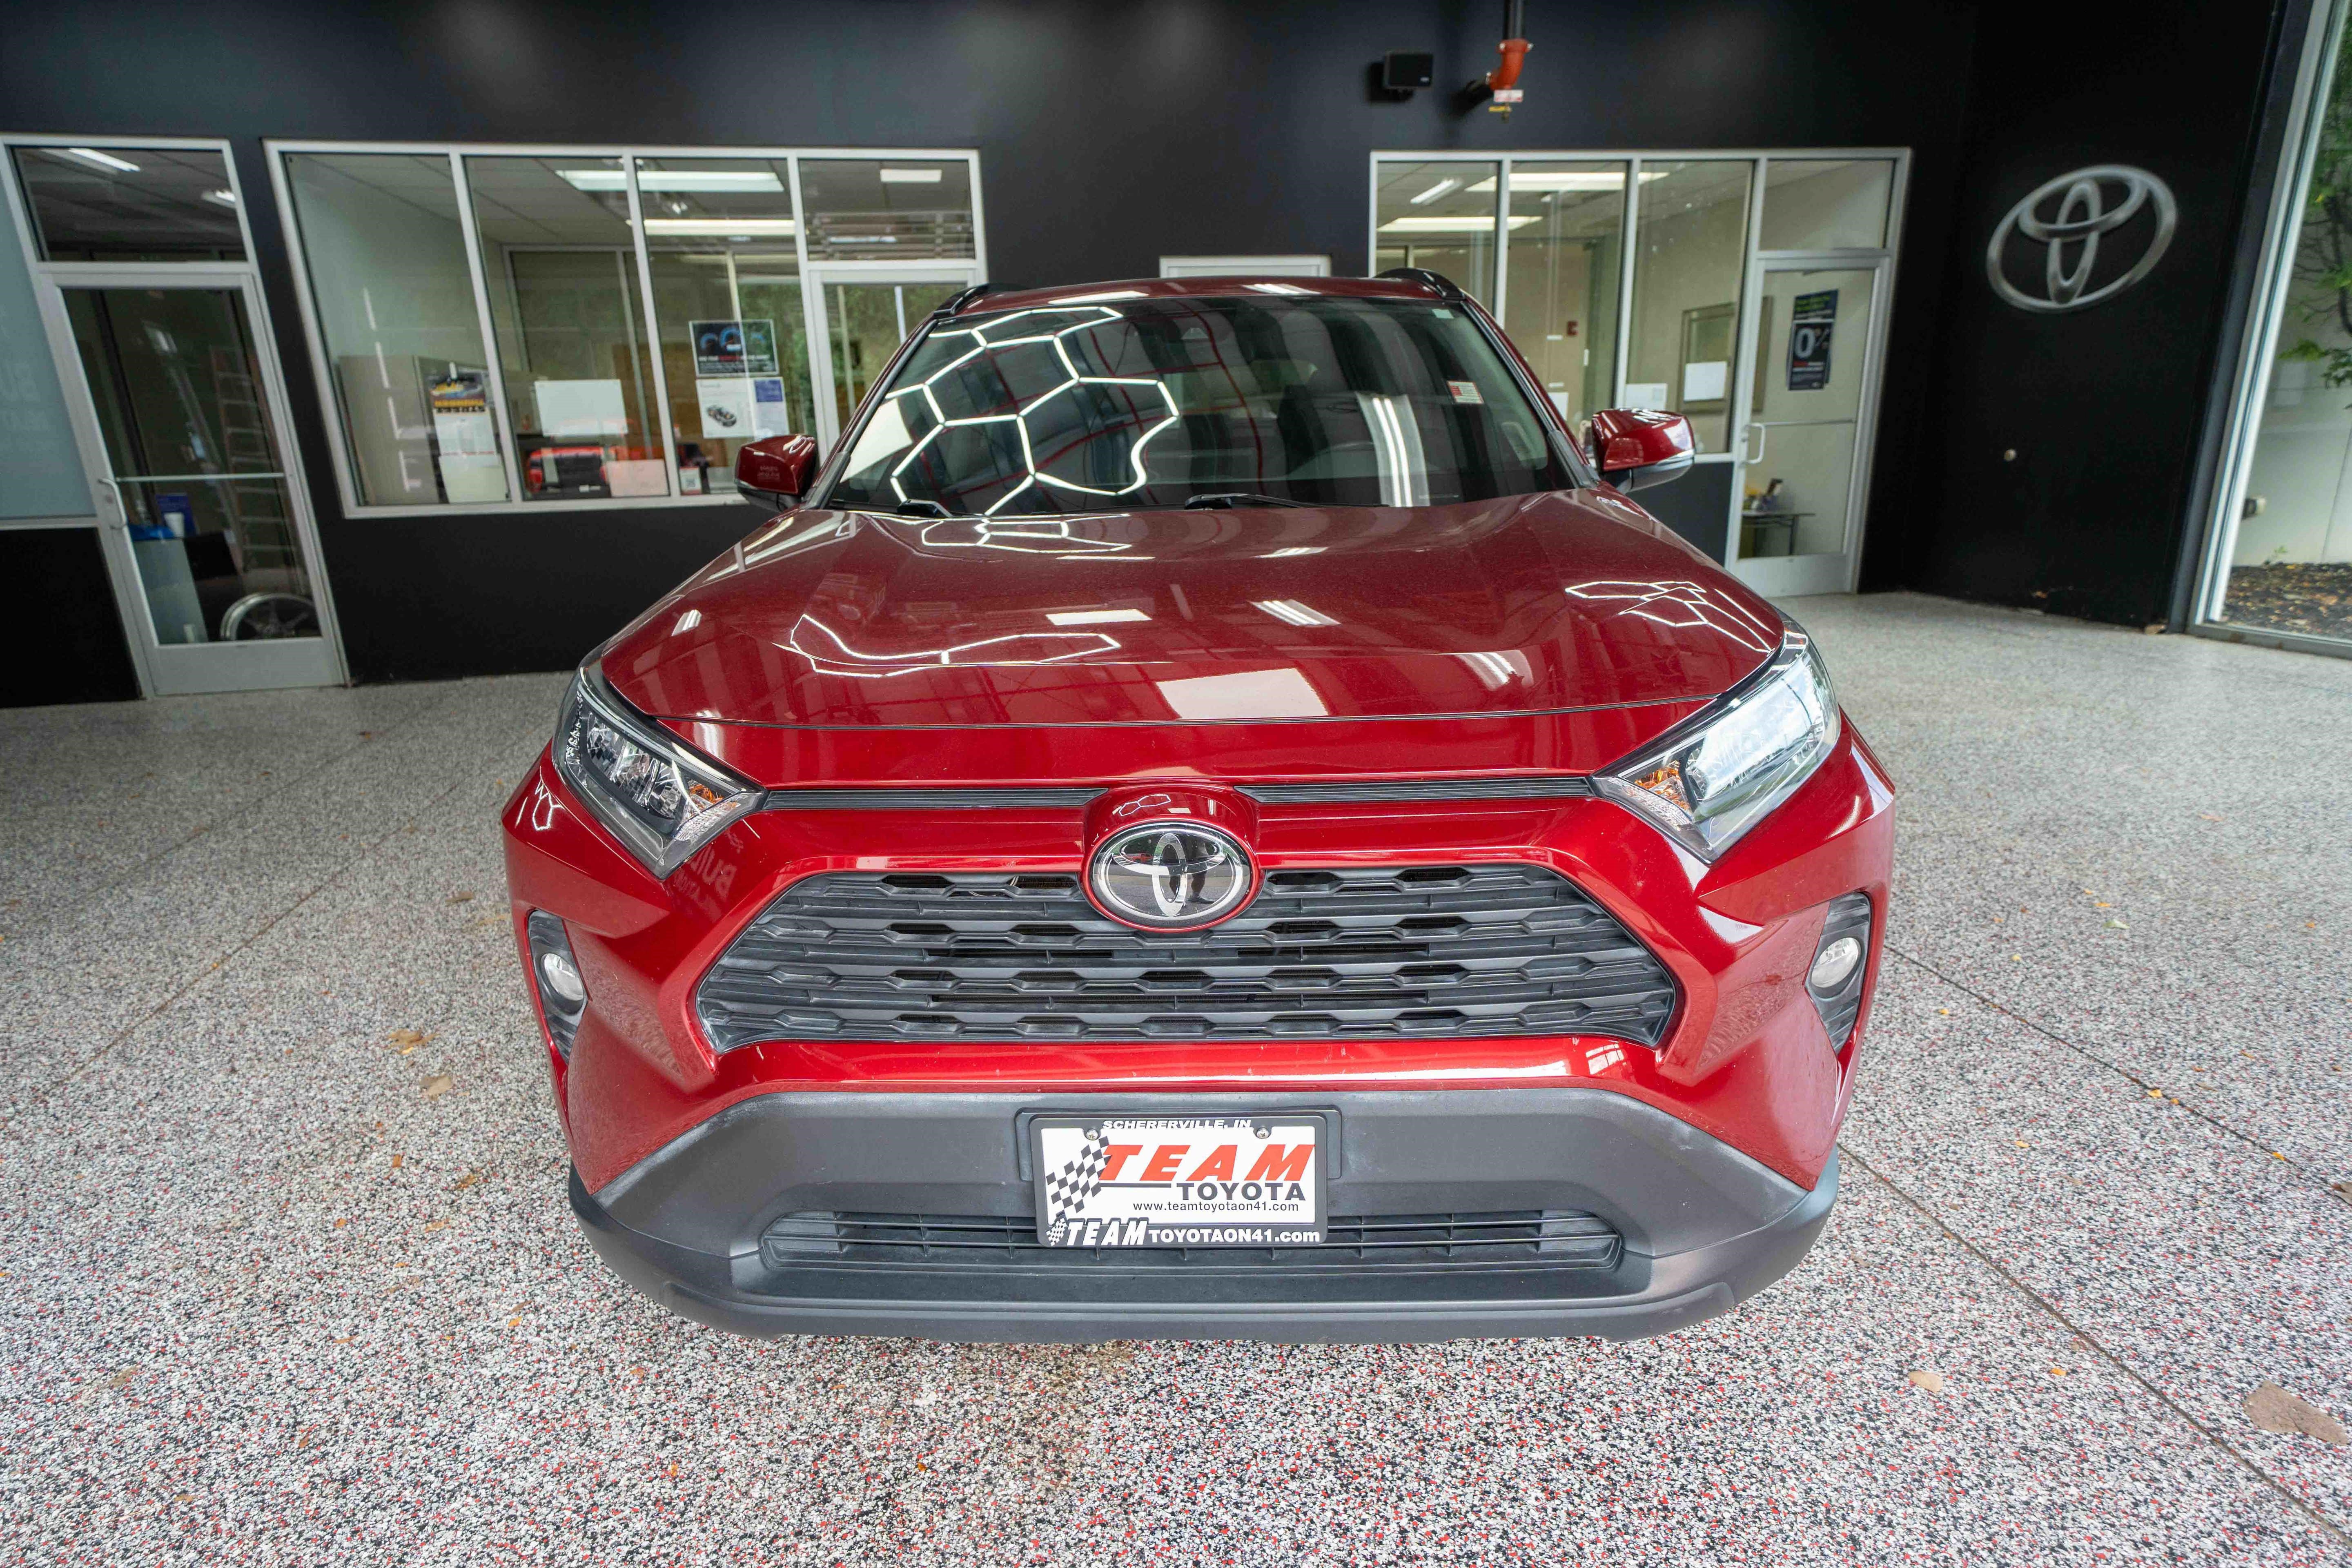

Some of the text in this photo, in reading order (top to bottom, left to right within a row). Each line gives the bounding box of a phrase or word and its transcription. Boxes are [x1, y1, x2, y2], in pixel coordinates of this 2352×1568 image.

[1232, 1119, 1252, 1128] IN
[1099, 1144, 1315, 1181] TEAM
[1176, 1183, 1305, 1201] TOYOTA
[1133, 1202, 1299, 1213] www.teamtoyotaon41.com
[1067, 1221, 1320, 1246] TEAM TOYOTAON41.com
